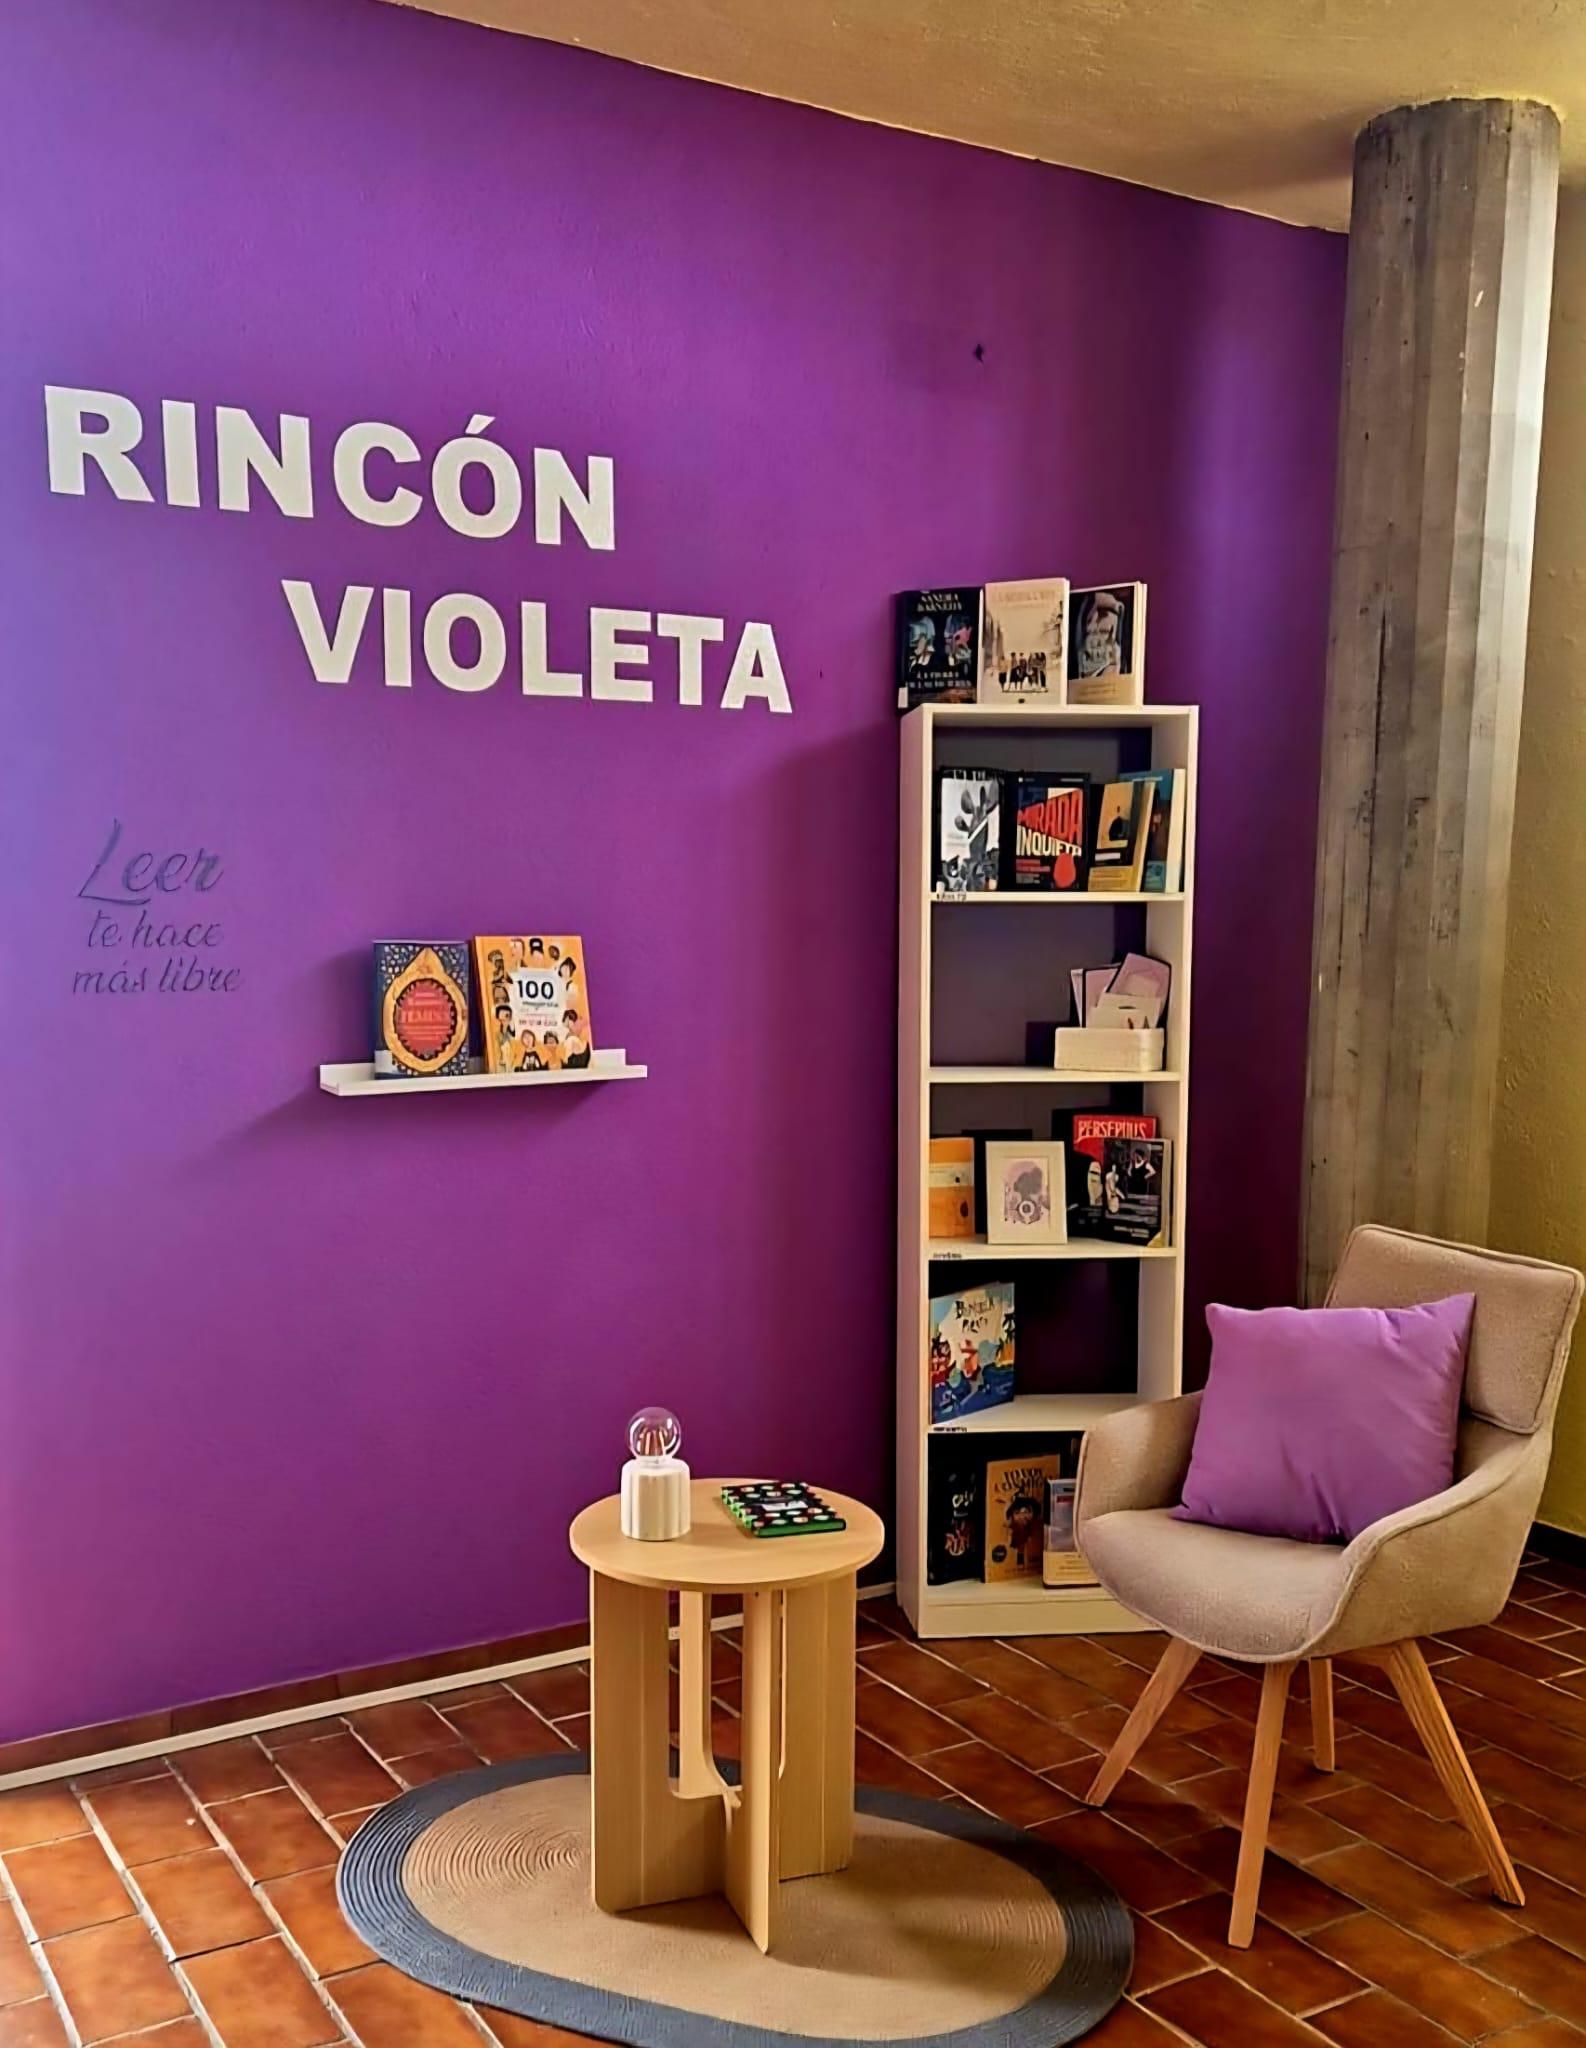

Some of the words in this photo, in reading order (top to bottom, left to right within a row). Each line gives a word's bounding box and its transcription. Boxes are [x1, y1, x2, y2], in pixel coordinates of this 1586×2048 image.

[44, 384, 616, 551] RINCÓN
[280, 578, 793, 714] VIOLETA
[78, 817, 224, 906] Leer
[88, 909, 122, 948] te
[131, 909, 223, 948] hace
[73, 959, 148, 995] más
[159, 955, 241, 993] libre
[517, 979, 554, 1000] 100
